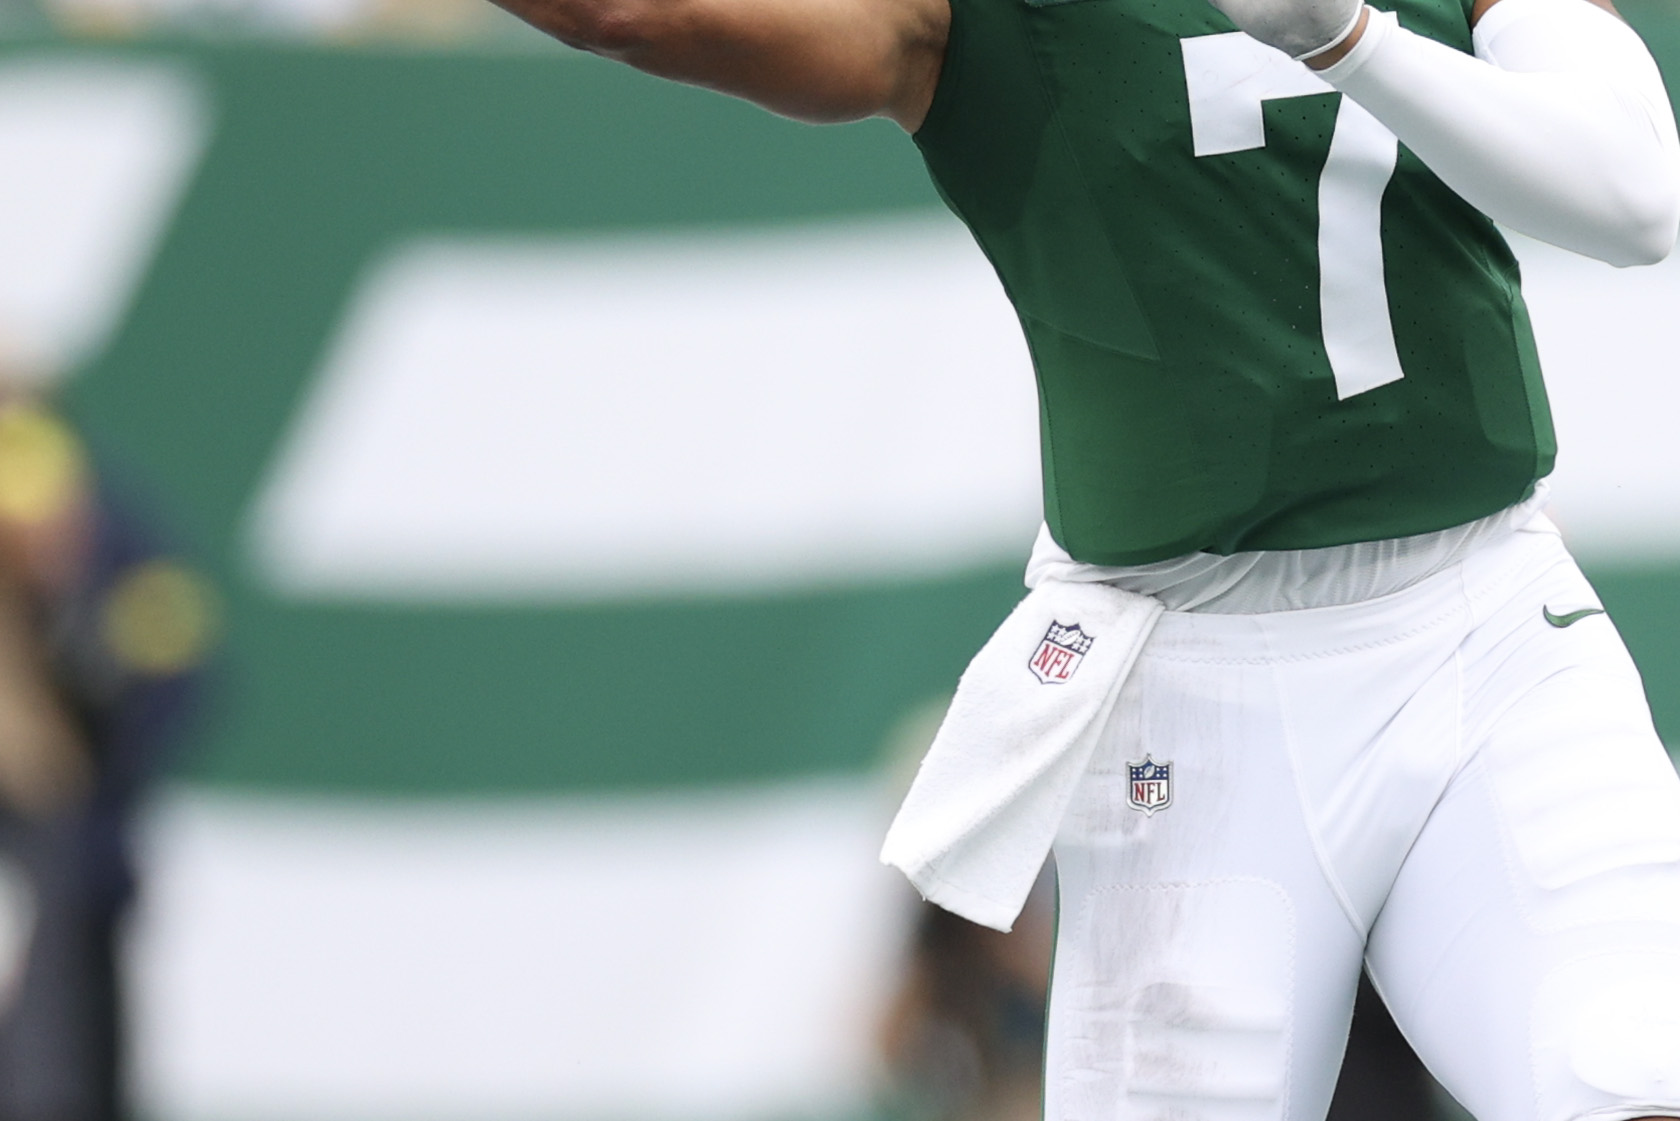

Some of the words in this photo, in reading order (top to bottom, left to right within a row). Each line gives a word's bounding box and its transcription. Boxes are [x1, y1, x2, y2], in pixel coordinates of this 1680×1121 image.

[1180, 11, 1404, 401] 7
[1034, 643, 1075, 680] NFL
[1134, 782, 1166, 805] NFL
